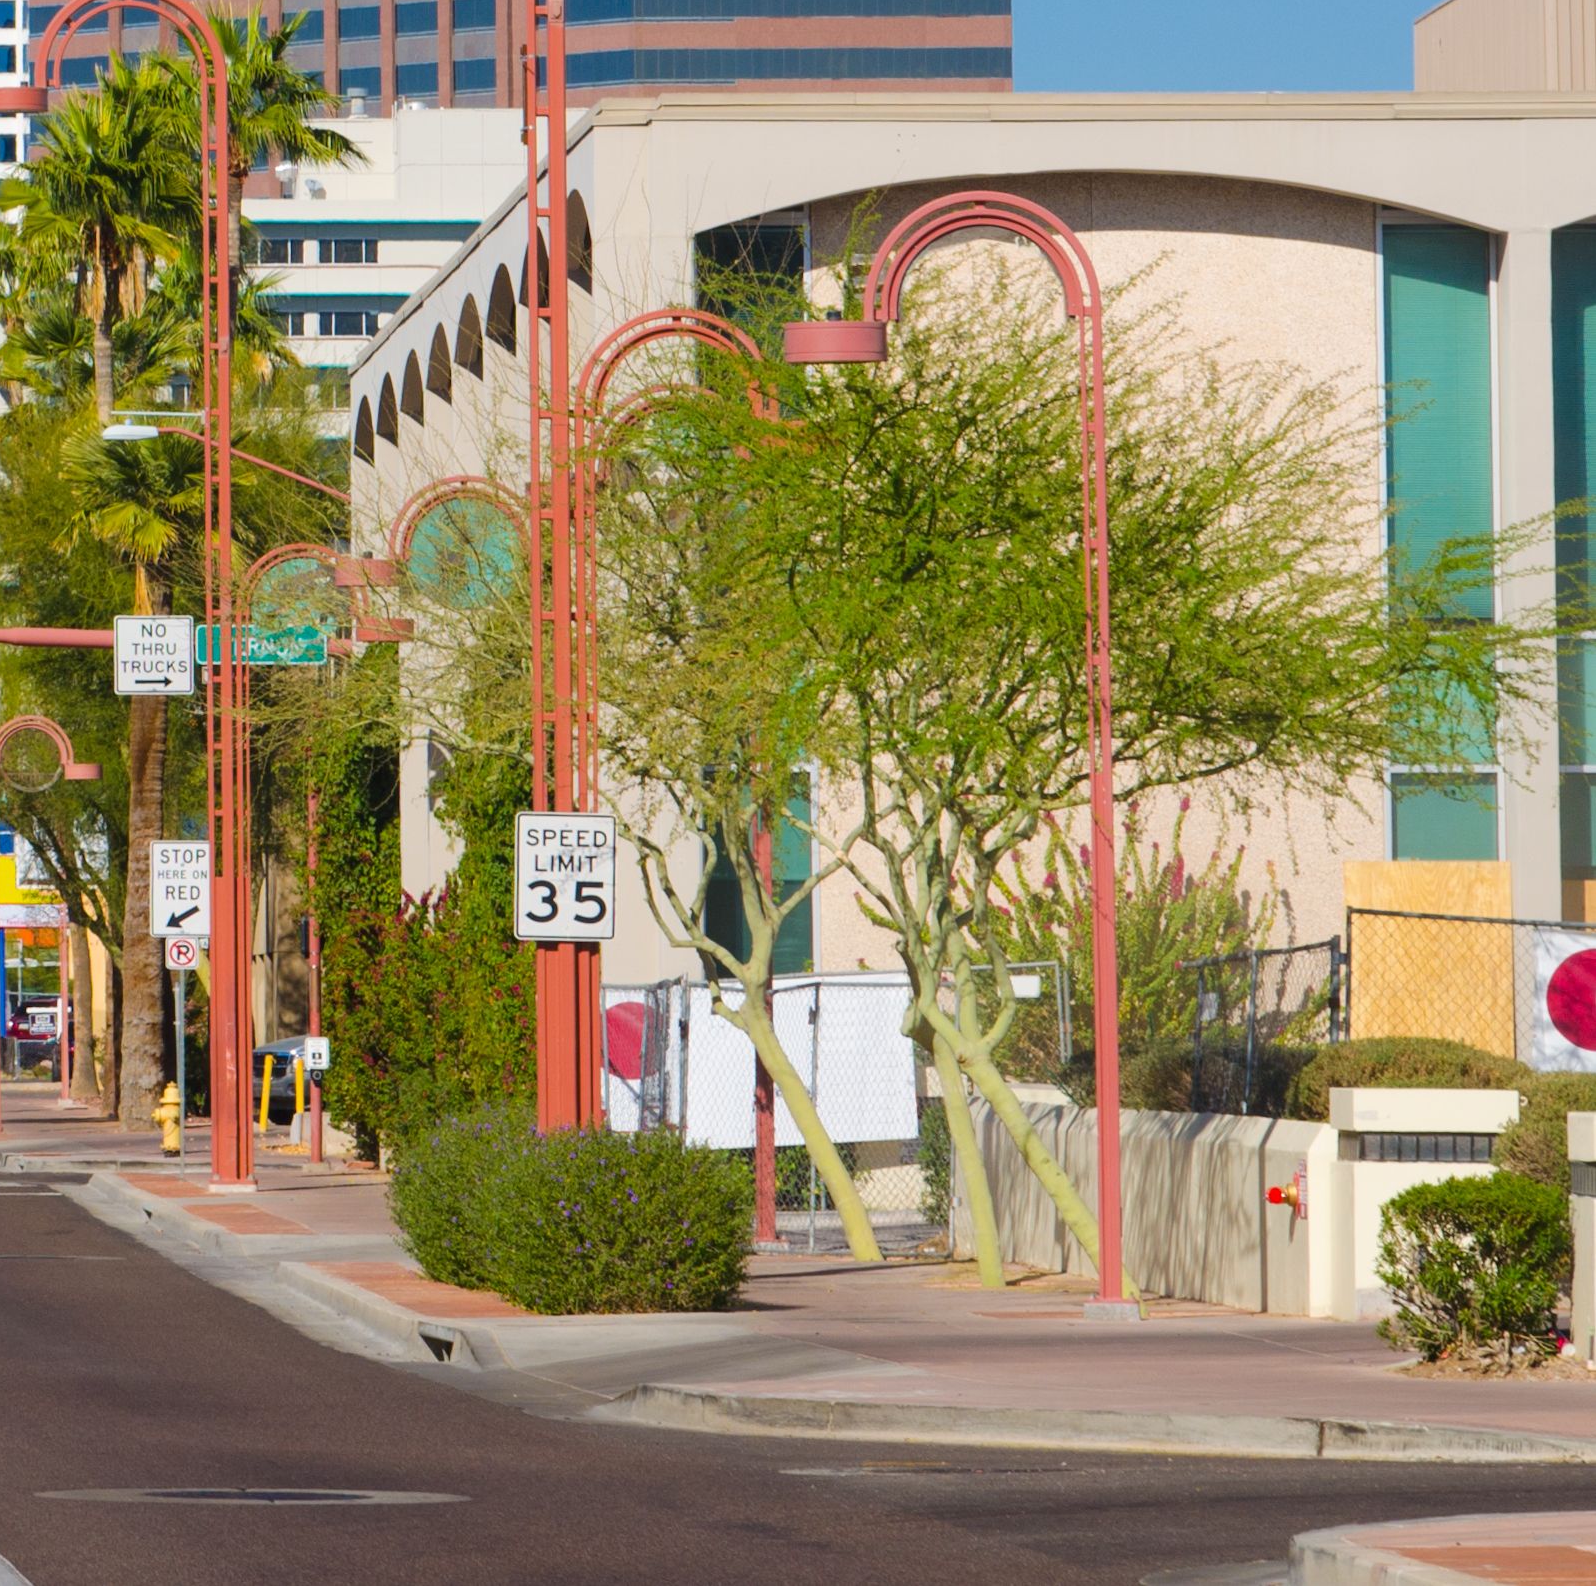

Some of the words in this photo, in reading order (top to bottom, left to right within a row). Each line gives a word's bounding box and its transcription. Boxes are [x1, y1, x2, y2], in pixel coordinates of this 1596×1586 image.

[140, 623, 167, 639] NO
[131, 642, 178, 657] THRU
[120, 660, 189, 674] TRUCKS
[526, 828, 608, 848] SPEED
[159, 848, 207, 865] STOP
[534, 854, 598, 873] LIMIT
[157, 869, 187, 880] HERE
[192, 869, 208, 880] ON
[165, 885, 201, 901] RED
[525, 879, 608, 925] 35
